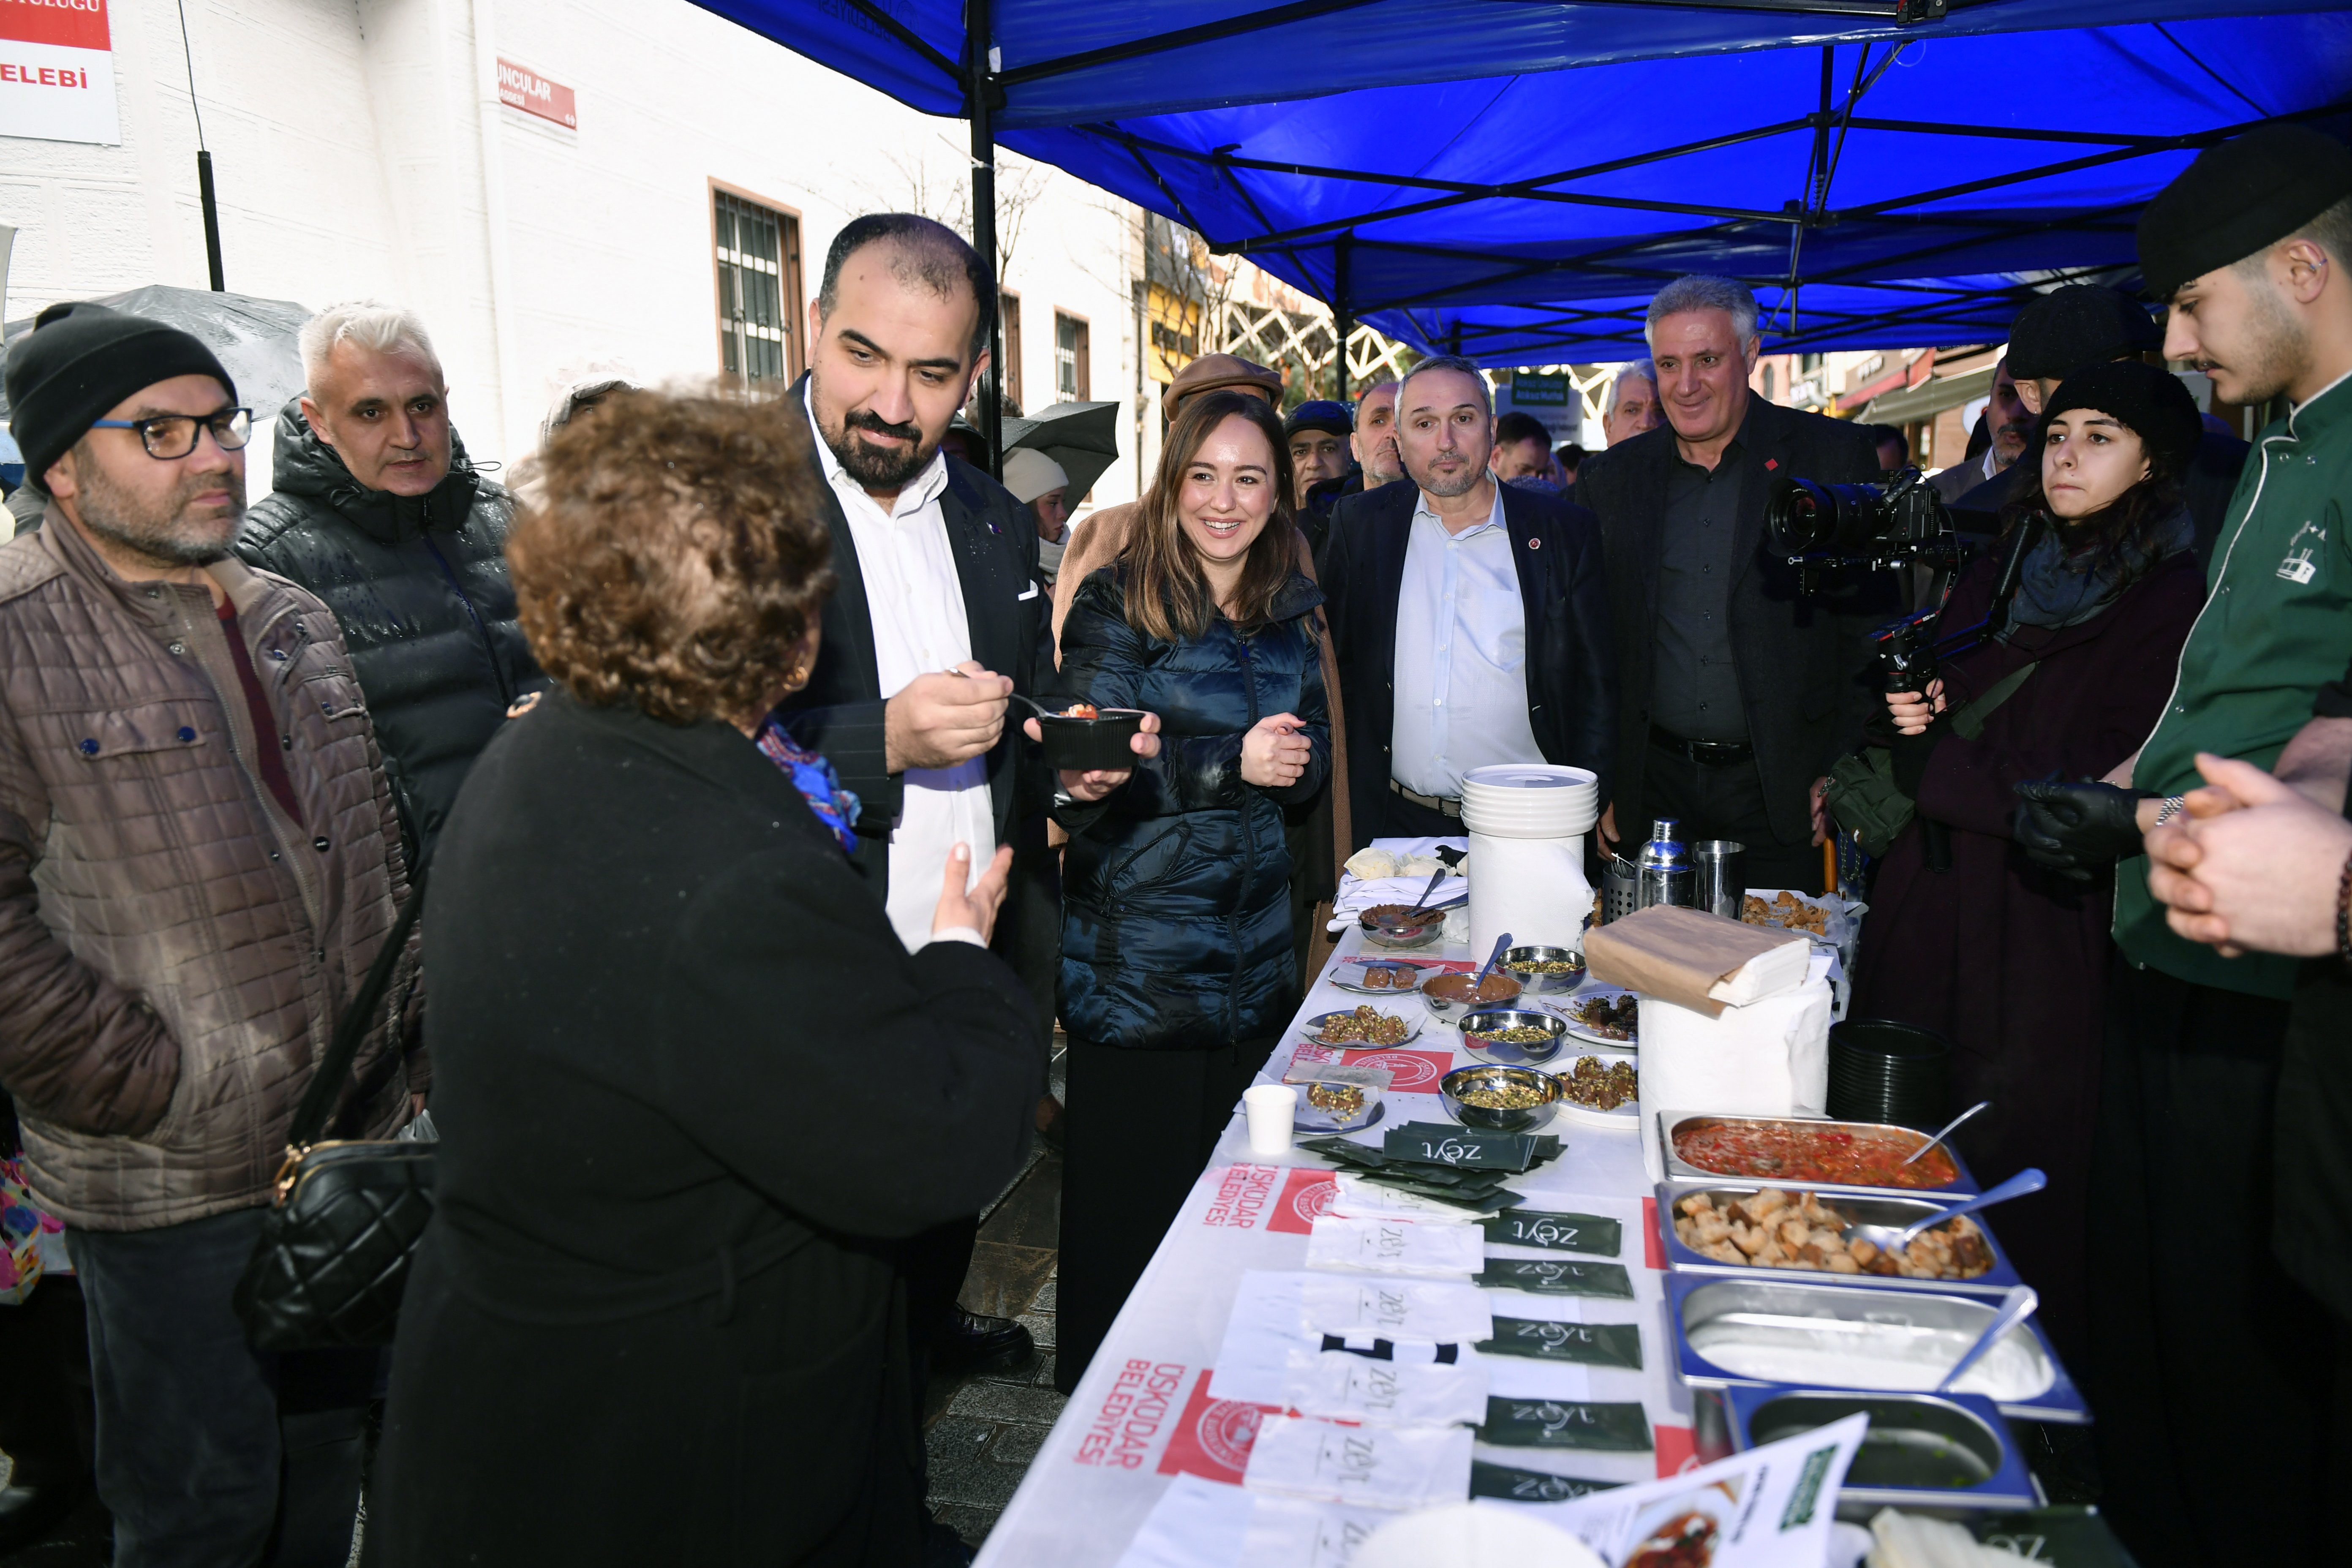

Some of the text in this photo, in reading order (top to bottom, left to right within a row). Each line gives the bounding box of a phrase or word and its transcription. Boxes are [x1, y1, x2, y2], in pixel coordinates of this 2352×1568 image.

[0, 63, 87, 89] ELEBİ
[1421, 1138, 1482, 1165] zeyt
[1512, 1218, 1579, 1247] zeyt
[1516, 1321, 1592, 1346] zeyt
